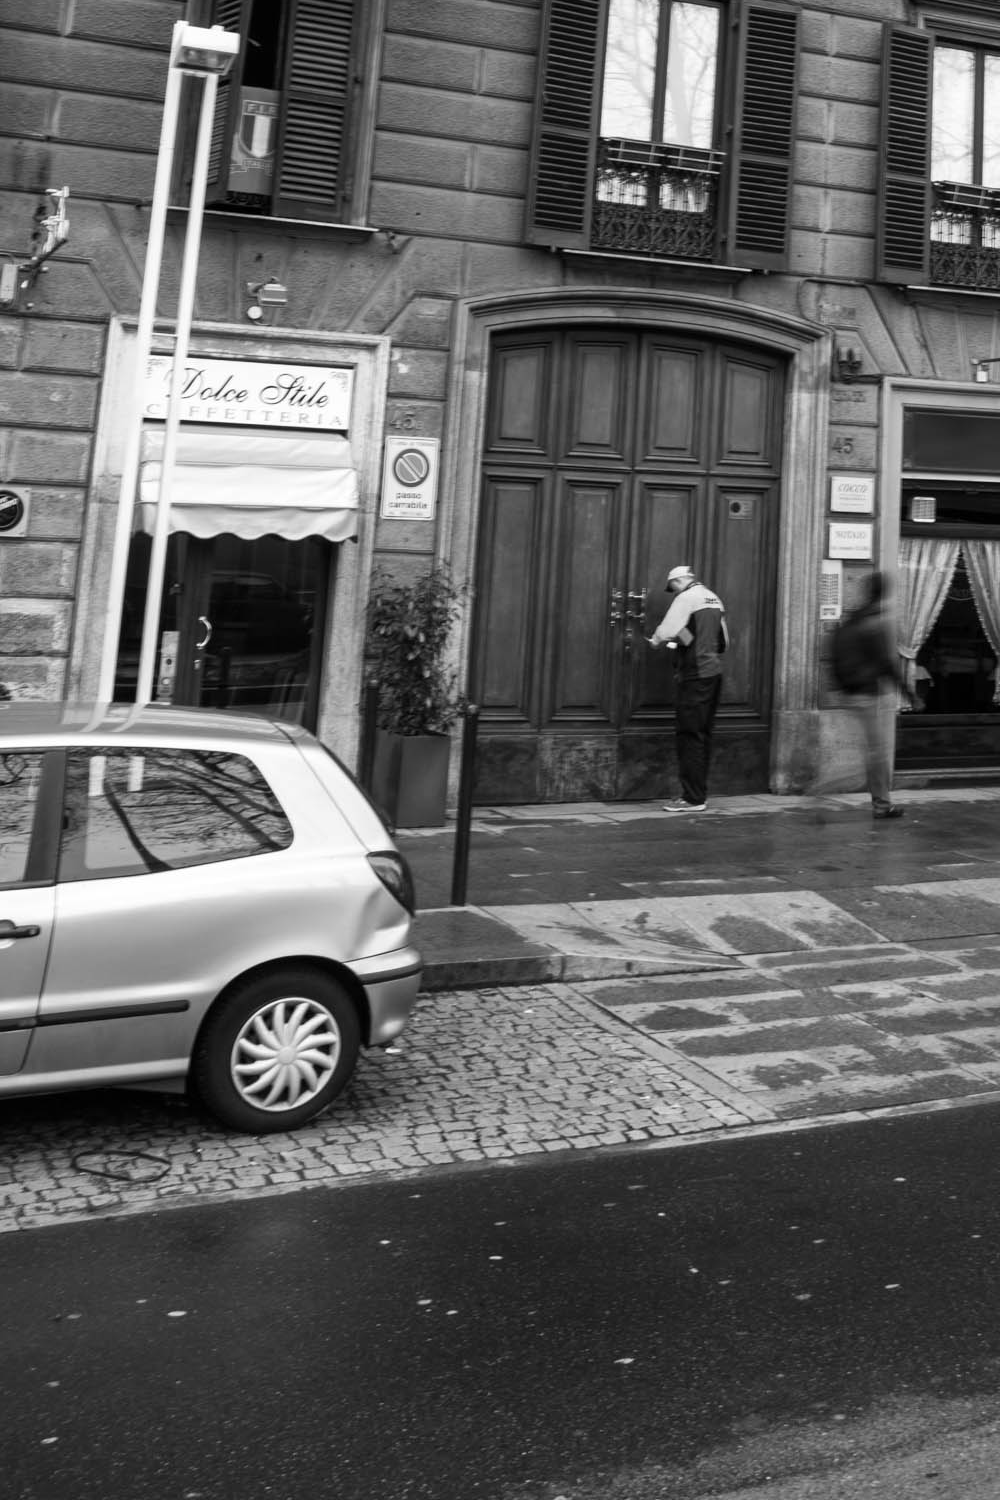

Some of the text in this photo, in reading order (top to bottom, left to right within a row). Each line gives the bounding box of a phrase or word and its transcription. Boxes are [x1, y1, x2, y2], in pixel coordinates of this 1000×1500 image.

[164, 367, 330, 409] Dolce Stile
[145, 402, 345, 426] CFFETTERIA
[831, 436, 854, 454] 45
[395, 491, 423, 500] passo
[388, 500, 429, 510] carrabile
